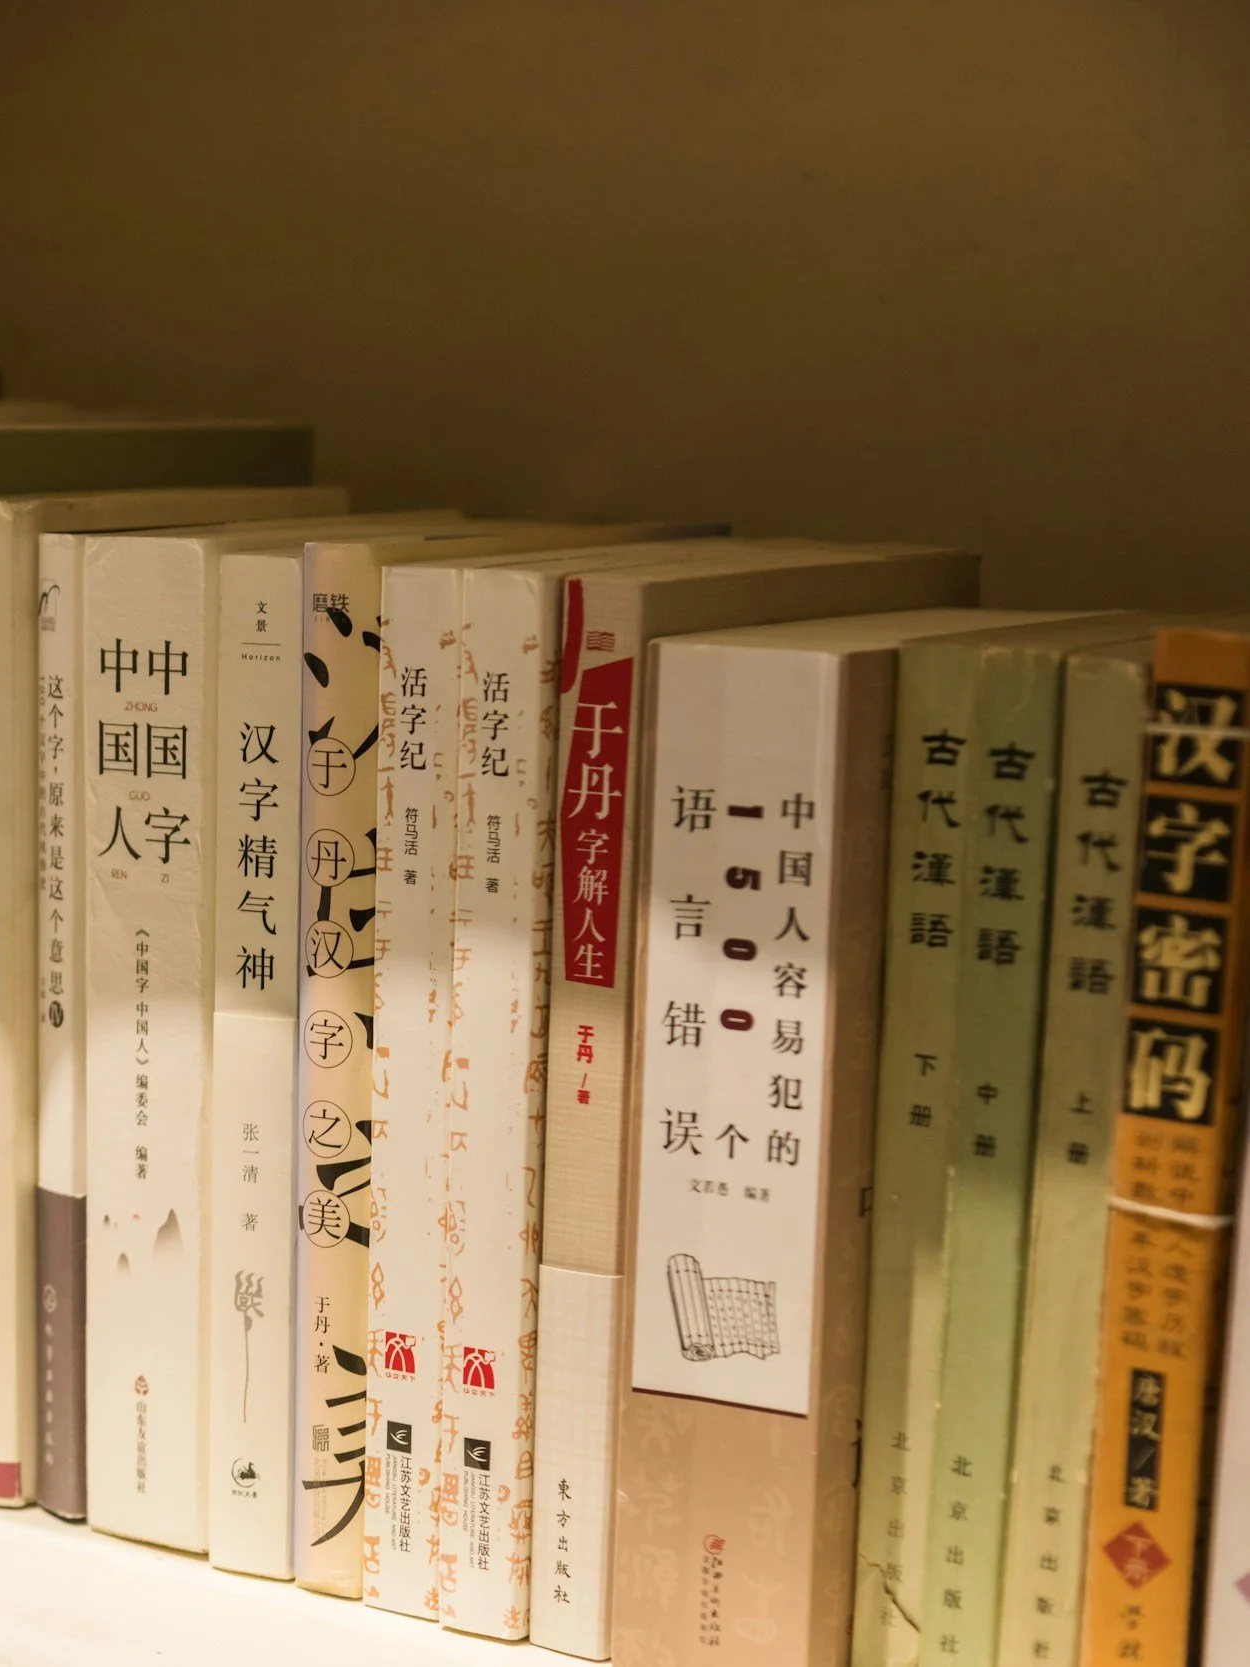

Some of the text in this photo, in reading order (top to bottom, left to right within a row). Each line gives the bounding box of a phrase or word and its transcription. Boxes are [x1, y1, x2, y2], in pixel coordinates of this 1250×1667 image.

[256, 601, 268, 633] 文景
[312, 593, 350, 614] 磨铁
[125, 701, 158, 713] ZHONG
[241, 652, 281, 663] Horizon
[98, 638, 141, 862] 中国人
[144, 640, 191, 866] 中国字
[400, 667, 427, 771] 活字纪
[481, 671, 510, 777] 活字纪
[129, 790, 151, 802] GUO
[403, 808, 418, 885] 符马活 著
[910, 728, 966, 949] 古代漢語
[111, 869, 128, 880] REN
[161, 872, 170, 883] ZI
[236, 722, 281, 991] 汉字精气神
[485, 815, 501, 893] 符马活 著
[976, 741, 1036, 967] 古代漢語
[1067, 767, 1129, 996] 古代漢語
[1128, 690, 1239, 1121] 汉字密码
[307, 748, 348, 1240] 于丹汉字之美
[659, 785, 717, 1158] 语言错误
[767, 792, 816, 1167] 中国人容易犯的
[135, 1145, 149, 1180] 编著
[241, 1123, 260, 1232] 张一清 著
[744, 1185, 771, 1203] 编著
[399, 1456, 412, 1552] 江苏文艺出版社
[477, 1473, 491, 1571] 江苏文艺出版社
[553, 1478, 572, 1605] 東方出版社
[939, 1455, 973, 1656] 北京出版社
[1032, 1464, 1066, 1661] 北京出版社
